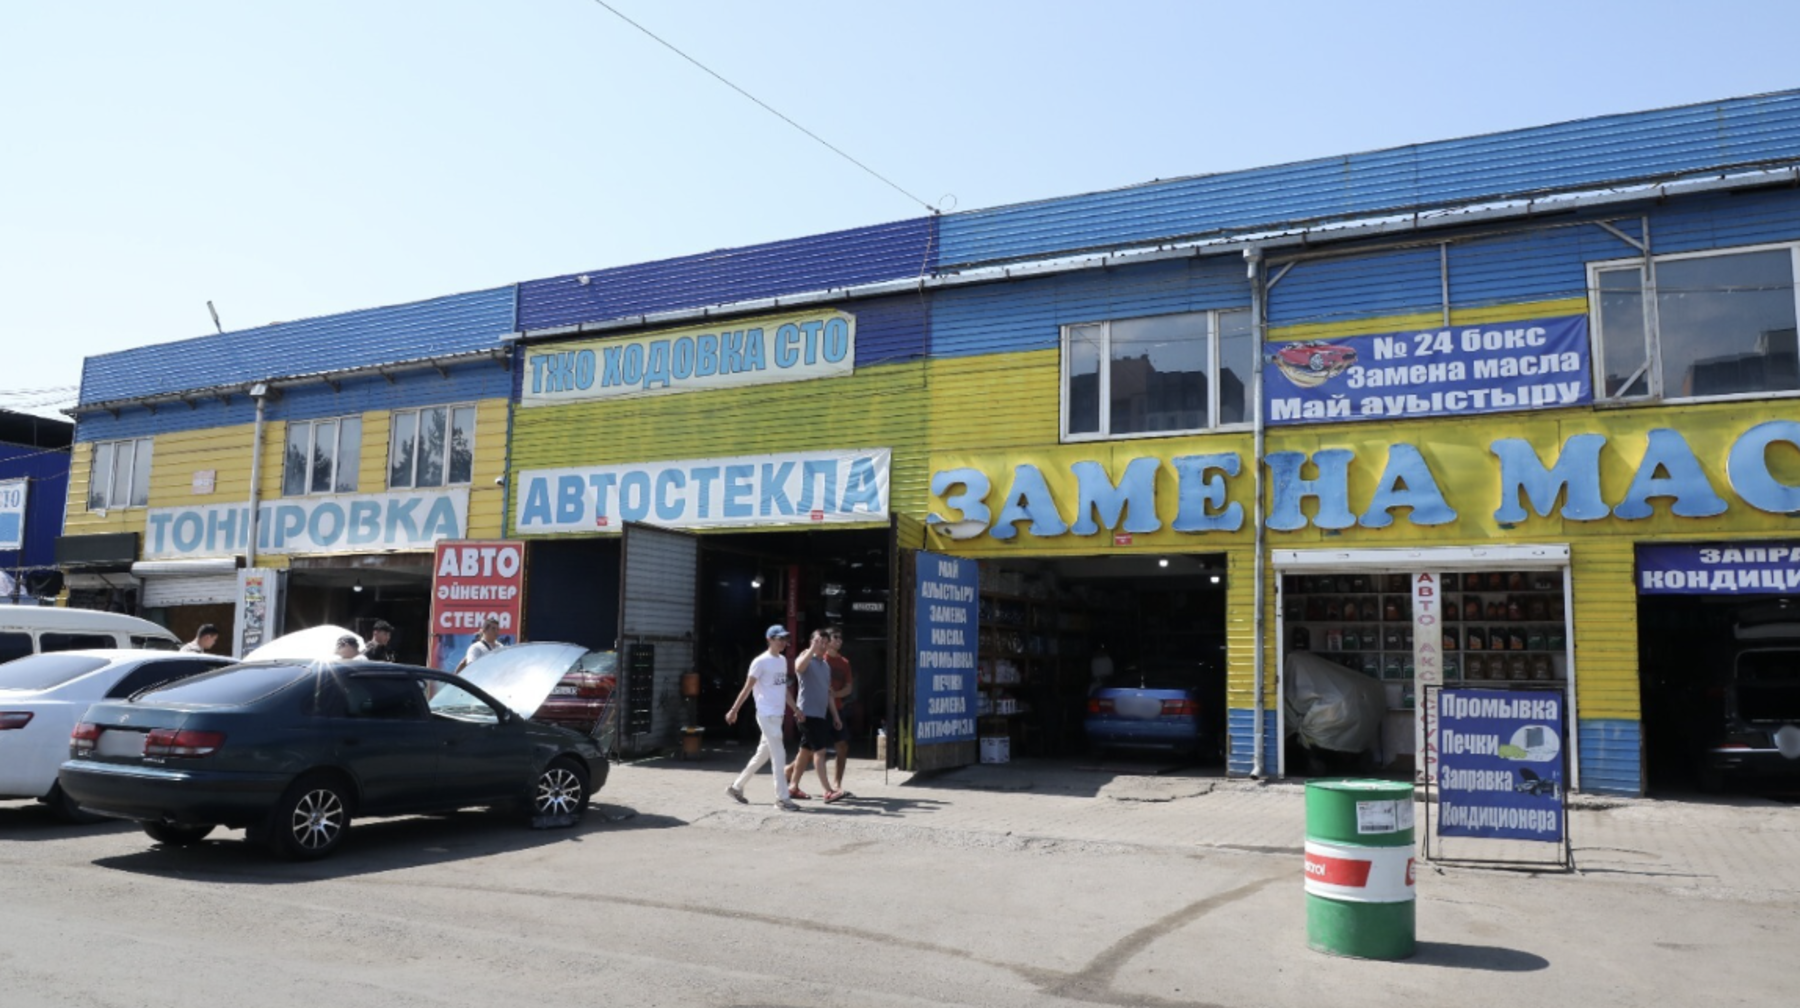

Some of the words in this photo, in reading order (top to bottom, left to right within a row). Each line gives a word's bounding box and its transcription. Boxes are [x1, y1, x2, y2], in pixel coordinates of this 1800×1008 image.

[530, 349, 595, 393] ТЖО
[601, 328, 766, 390] ХОДОВКА
[774, 316, 849, 368] СТО
[1373, 338, 1407, 360] №
[1414, 333, 1453, 356] 24
[1461, 327, 1546, 351] бокс
[1347, 361, 1466, 389] Замена
[1473, 352, 1581, 377] масла
[1271, 394, 1350, 421] Май
[1360, 381, 1581, 416] ауыстыру
[521, 457, 881, 526] АВТОСТЕКЛА
[926, 443, 1458, 540] ЗАМЕНА
[1490, 420, 1800, 524] МАС
[0, 489, 20, 508] ТО
[150, 496, 459, 553] ТОНИРОВКА
[438, 547, 520, 578] АВТО
[938, 560, 959, 578] МАЙ
[921, 581, 974, 602] АУЫСТЫРУ
[1642, 569, 1800, 591] КОНДИЦИ
[1417, 572, 1435, 626] АВТО
[929, 605, 967, 624] ЗАМЕНА
[920, 651, 974, 668] ПРОМЫВКА
[928, 696, 966, 714] ЗАМЕНА
[1442, 694, 1558, 720] Промывка
[1442, 729, 1499, 756] Печки
[1441, 765, 1513, 792] Заправка
[1442, 802, 1557, 833] Кондиционера
